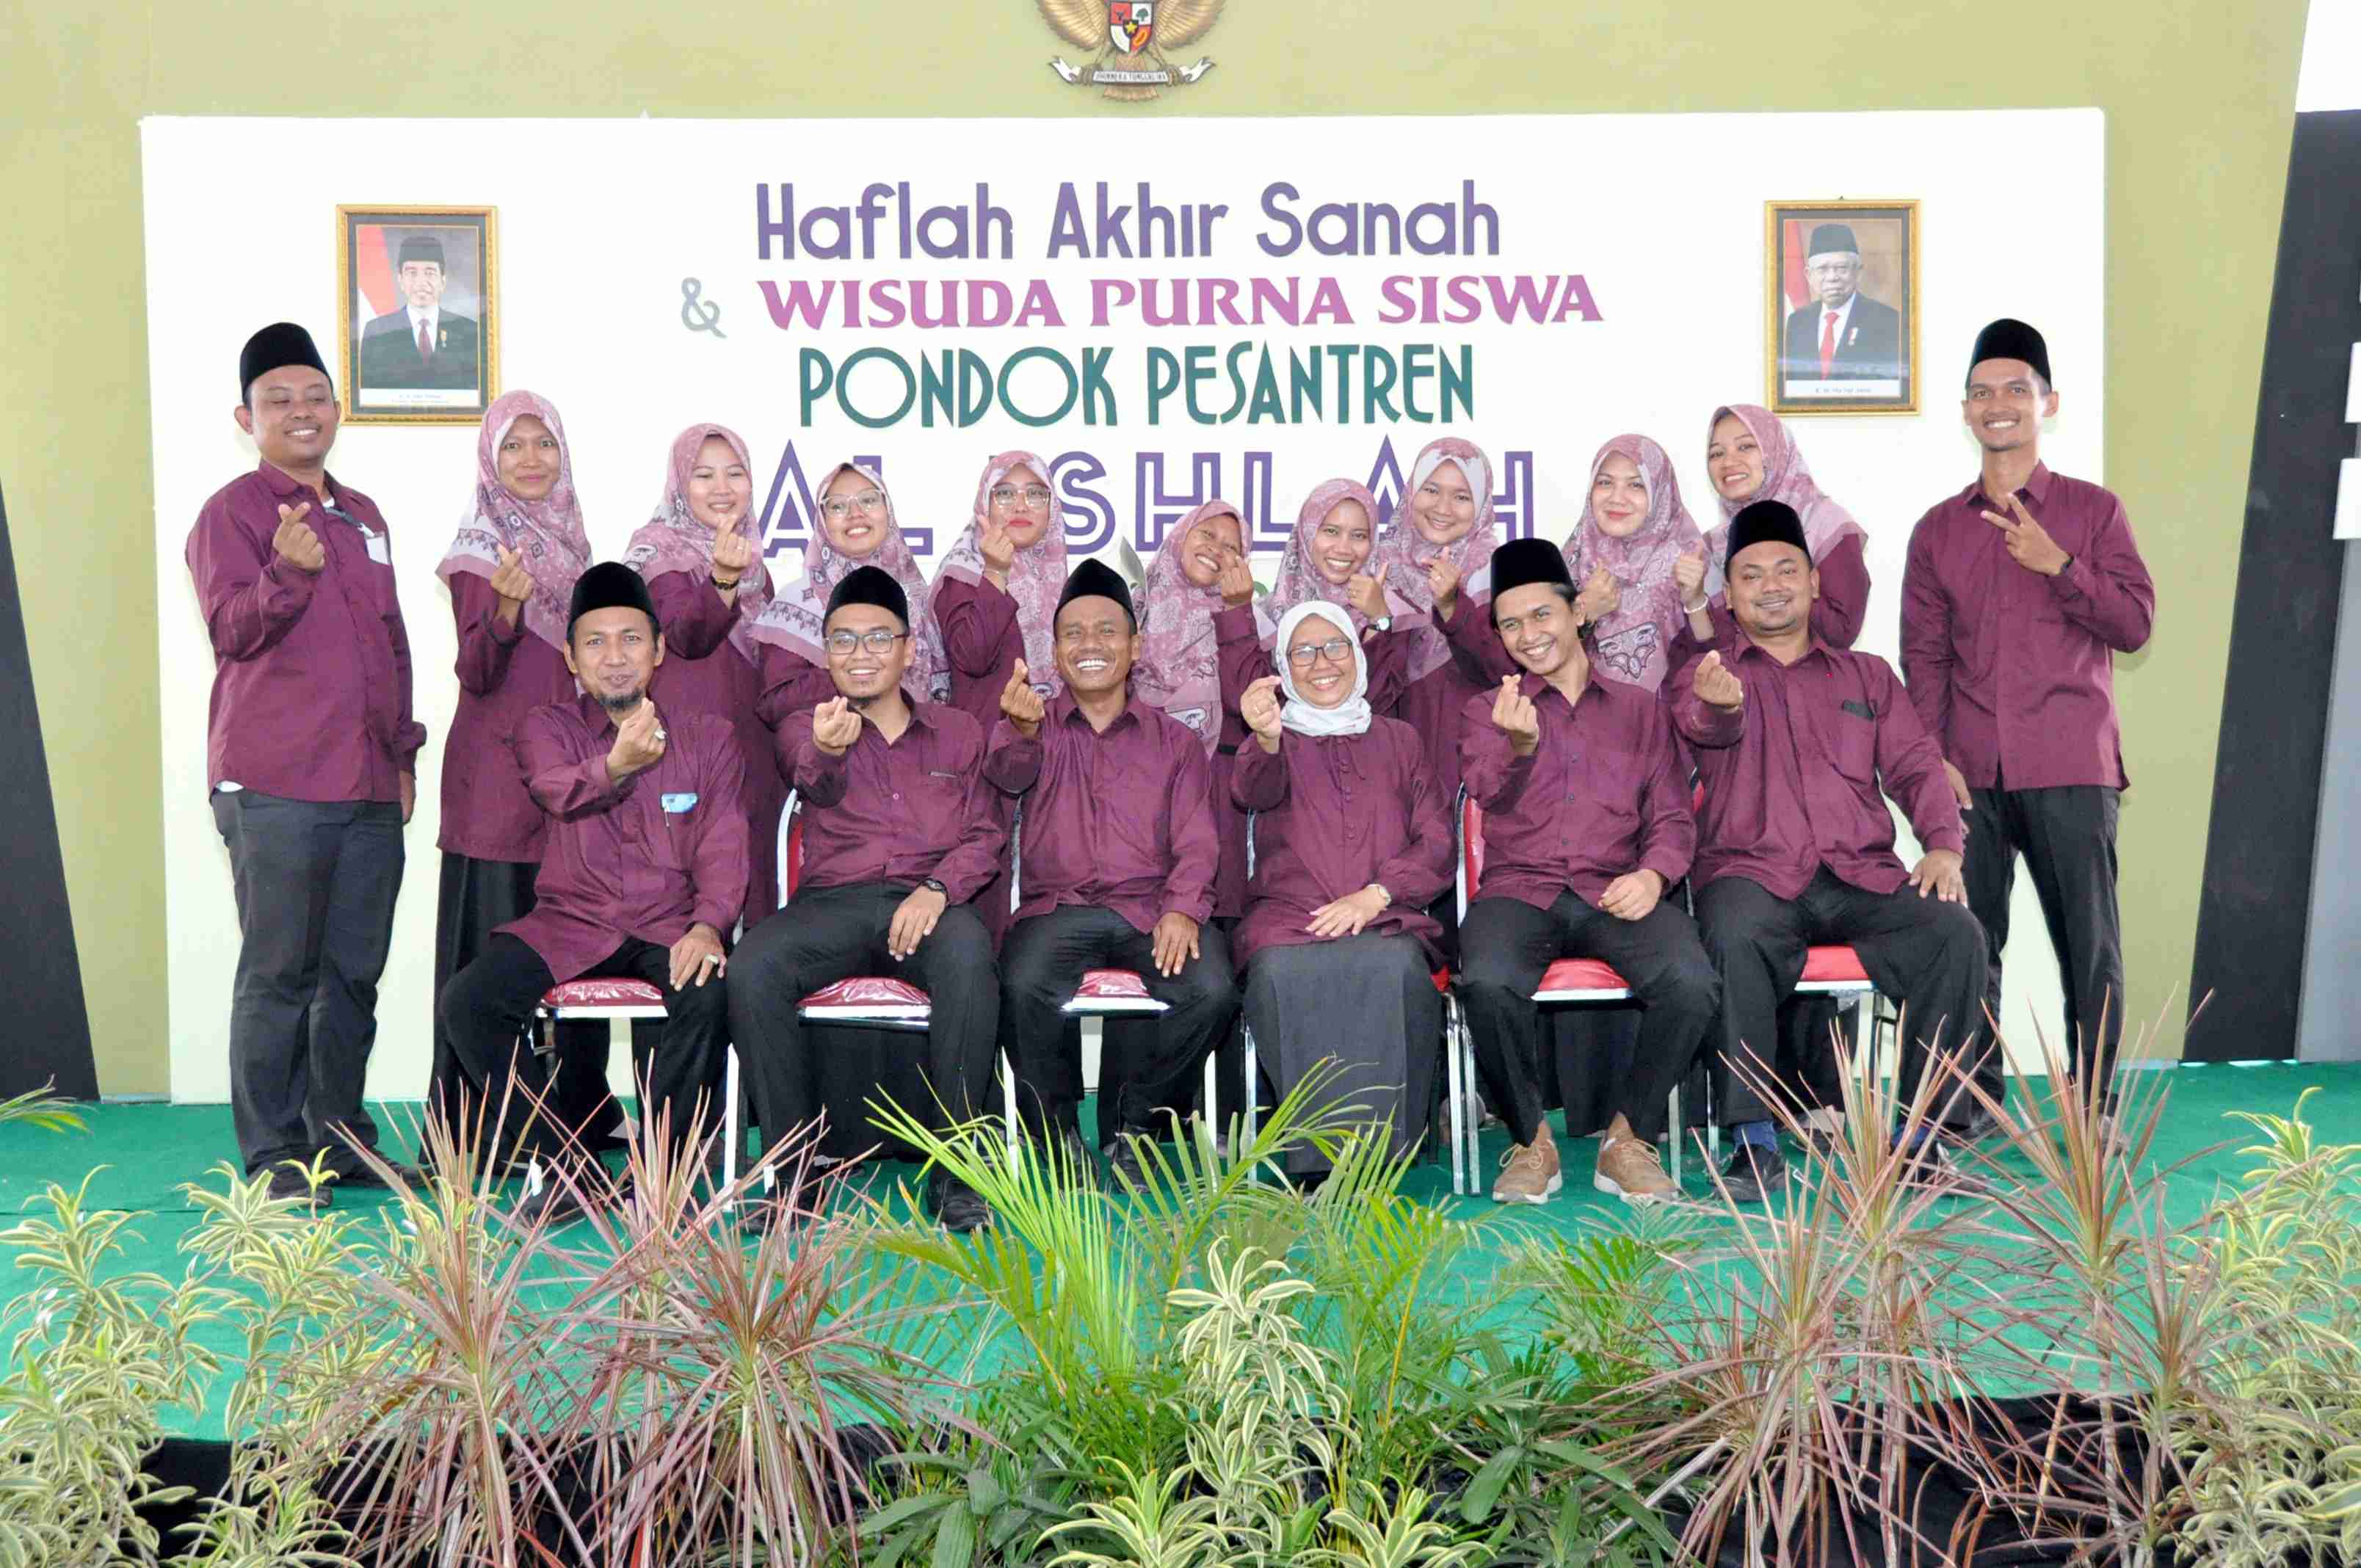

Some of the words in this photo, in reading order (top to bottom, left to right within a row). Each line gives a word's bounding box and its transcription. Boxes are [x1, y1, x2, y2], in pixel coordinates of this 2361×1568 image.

[756, 181, 1013, 260] Haflah
[1046, 181, 1230, 259] Akhir
[1256, 179, 1500, 258] Sanah
[681, 277, 728, 339] &
[756, 279, 1067, 331] WISUDA
[1090, 277, 1355, 327] PURNA
[1378, 275, 1604, 325] SISWA
[799, 346, 1118, 429] PONDOK
[1147, 341, 1474, 427] PESANTREN
[988, 433, 1534, 556] SHLAH
